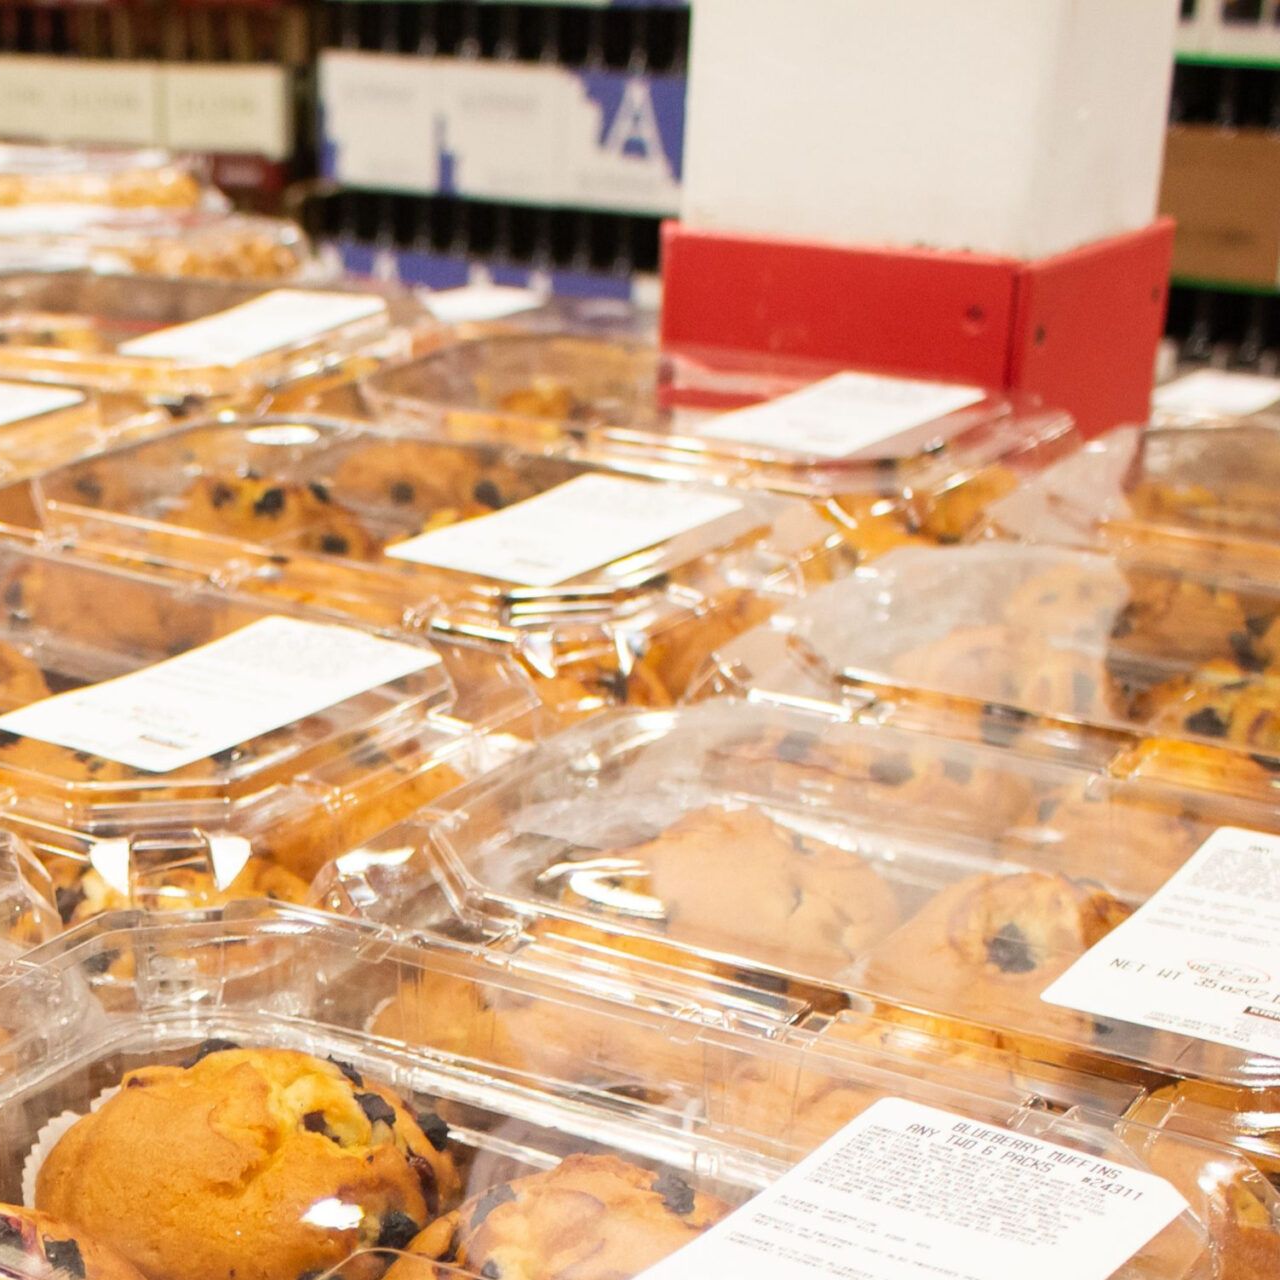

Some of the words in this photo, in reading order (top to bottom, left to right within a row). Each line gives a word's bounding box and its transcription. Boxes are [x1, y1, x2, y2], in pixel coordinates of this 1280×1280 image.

[1110, 957, 1150, 973] NET
[907, 1123, 941, 1139] ANY
[946, 1135, 976, 1150] TWO
[981, 1144, 993, 1156] 6
[1000, 1150, 1055, 1173] PACKS
[1081, 1177, 1144, 1201] #24311
[952, 1122, 1045, 1155] BLUEBERRY
[1049, 1150, 1123, 1180] MUFFINS
